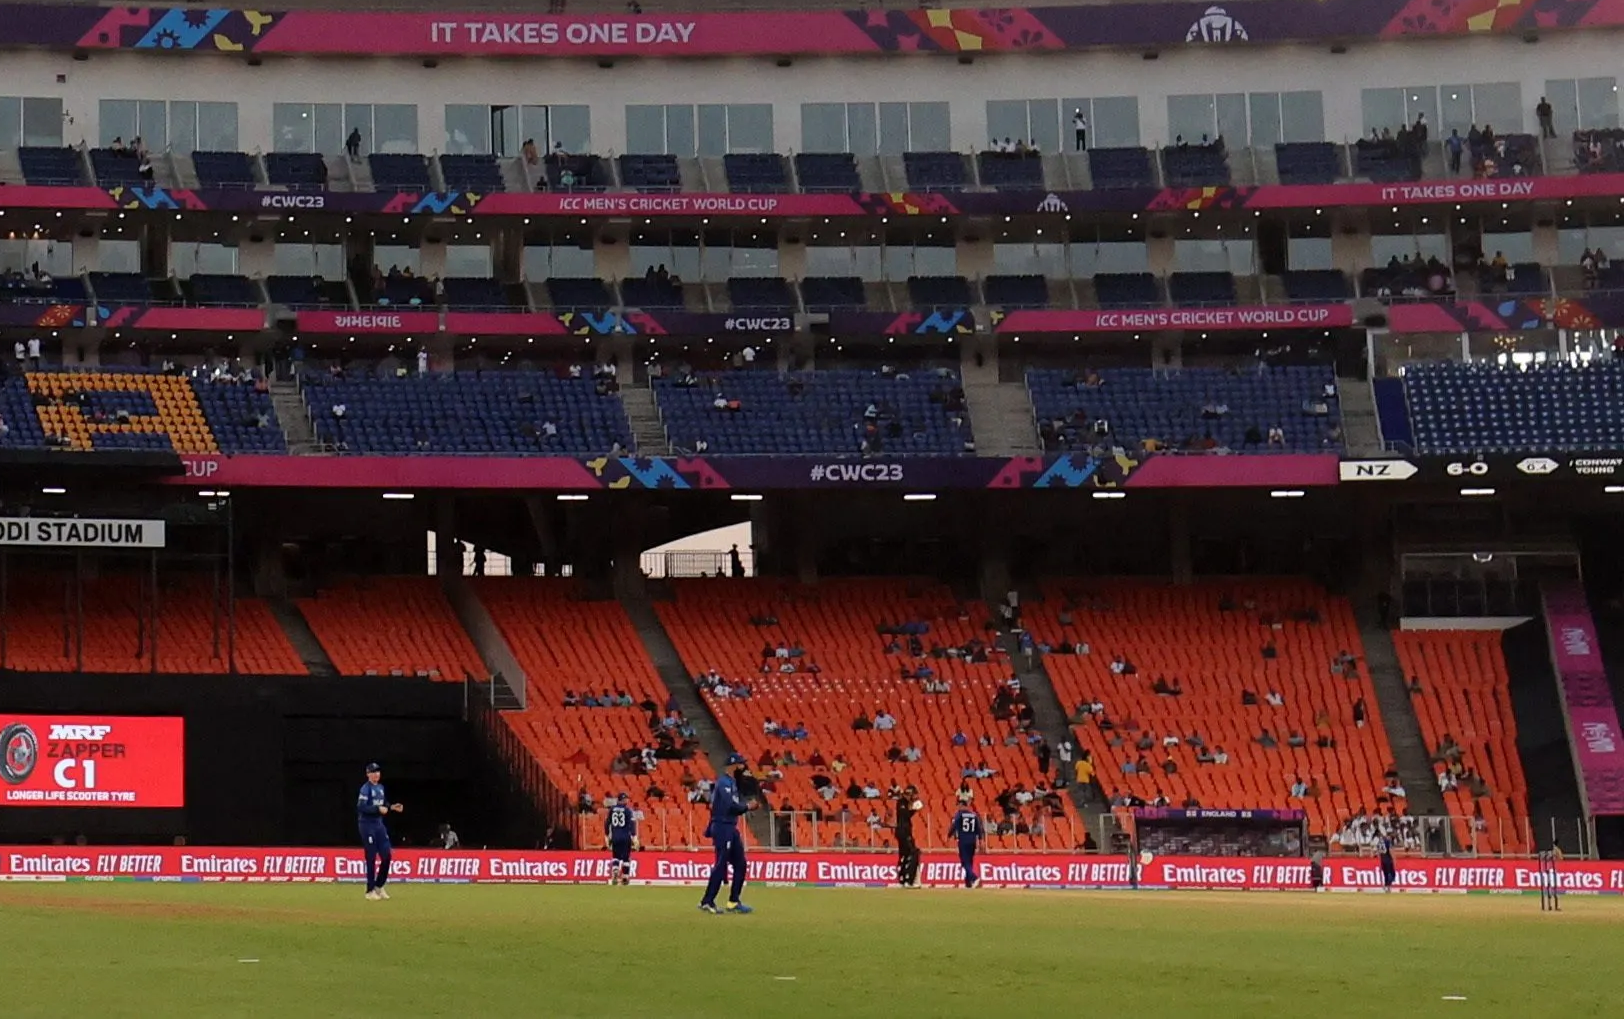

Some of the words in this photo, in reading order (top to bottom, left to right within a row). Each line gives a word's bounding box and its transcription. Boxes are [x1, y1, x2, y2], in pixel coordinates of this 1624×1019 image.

[431, 22, 457, 43] IT
[464, 22, 559, 44] TAKES
[566, 22, 628, 44] ONE
[636, 22, 696, 44] DAY
[1382, 187, 1398, 200] IT
[1401, 186, 1456, 199] TAKES
[1459, 184, 1496, 197] ONE
[1499, 182, 1534, 195] DAY
[261, 196, 325, 209] #CWC23
[559, 198, 581, 210] ICC
[583, 198, 627, 210] MEN'S
[629, 198, 690, 211] CRICKET
[692, 198, 747, 211] WORLD
[748, 198, 777, 211] CUP
[724, 317, 791, 331] #CWC23
[1095, 314, 1118, 327] ICC
[1121, 313, 1168, 327] MEN'S
[1170, 312, 1235, 326] CRICKET
[1238, 310, 1295, 324] WORLD
[1297, 309, 1329, 322] CUP
[809, 464, 904, 482] #CWC23
[1355, 464, 1392, 477] NZ
[36, 522, 143, 543] STADIUM
[47, 724, 111, 741] MRF
[46, 742, 126, 758] ZAPPER
[6, 789, 44, 800] LONGER
[45, 790, 66, 801] LIFE
[66, 791, 110, 801] SCOOTER
[111, 791, 136, 802] TYRE
[611, 812, 626, 827] 63
[962, 817, 976, 832] 51
[10, 853, 90, 873] Emirates
[97, 854, 119, 873] FLY
[119, 854, 162, 873] BETTER
[181, 854, 257, 874] Emirates
[263, 855, 285, 874] FLY
[285, 855, 325, 874] BETTER
[417, 857, 439, 876] FLY
[438, 857, 480, 876] BETTER
[489, 857, 567, 877] Emirates
[573, 859, 594, 877] FLY
[765, 861, 808, 880] BETTER
[817, 861, 898, 881] Emirates
[980, 861, 1061, 882] Emirates
[1067, 863, 1090, 881] FLY
[1163, 863, 1246, 883] Emirates
[1253, 865, 1275, 884] FLY
[1434, 868, 1459, 886] FLY
[1458, 868, 1504, 886] BETTER
[1515, 867, 1603, 888] Emirates
